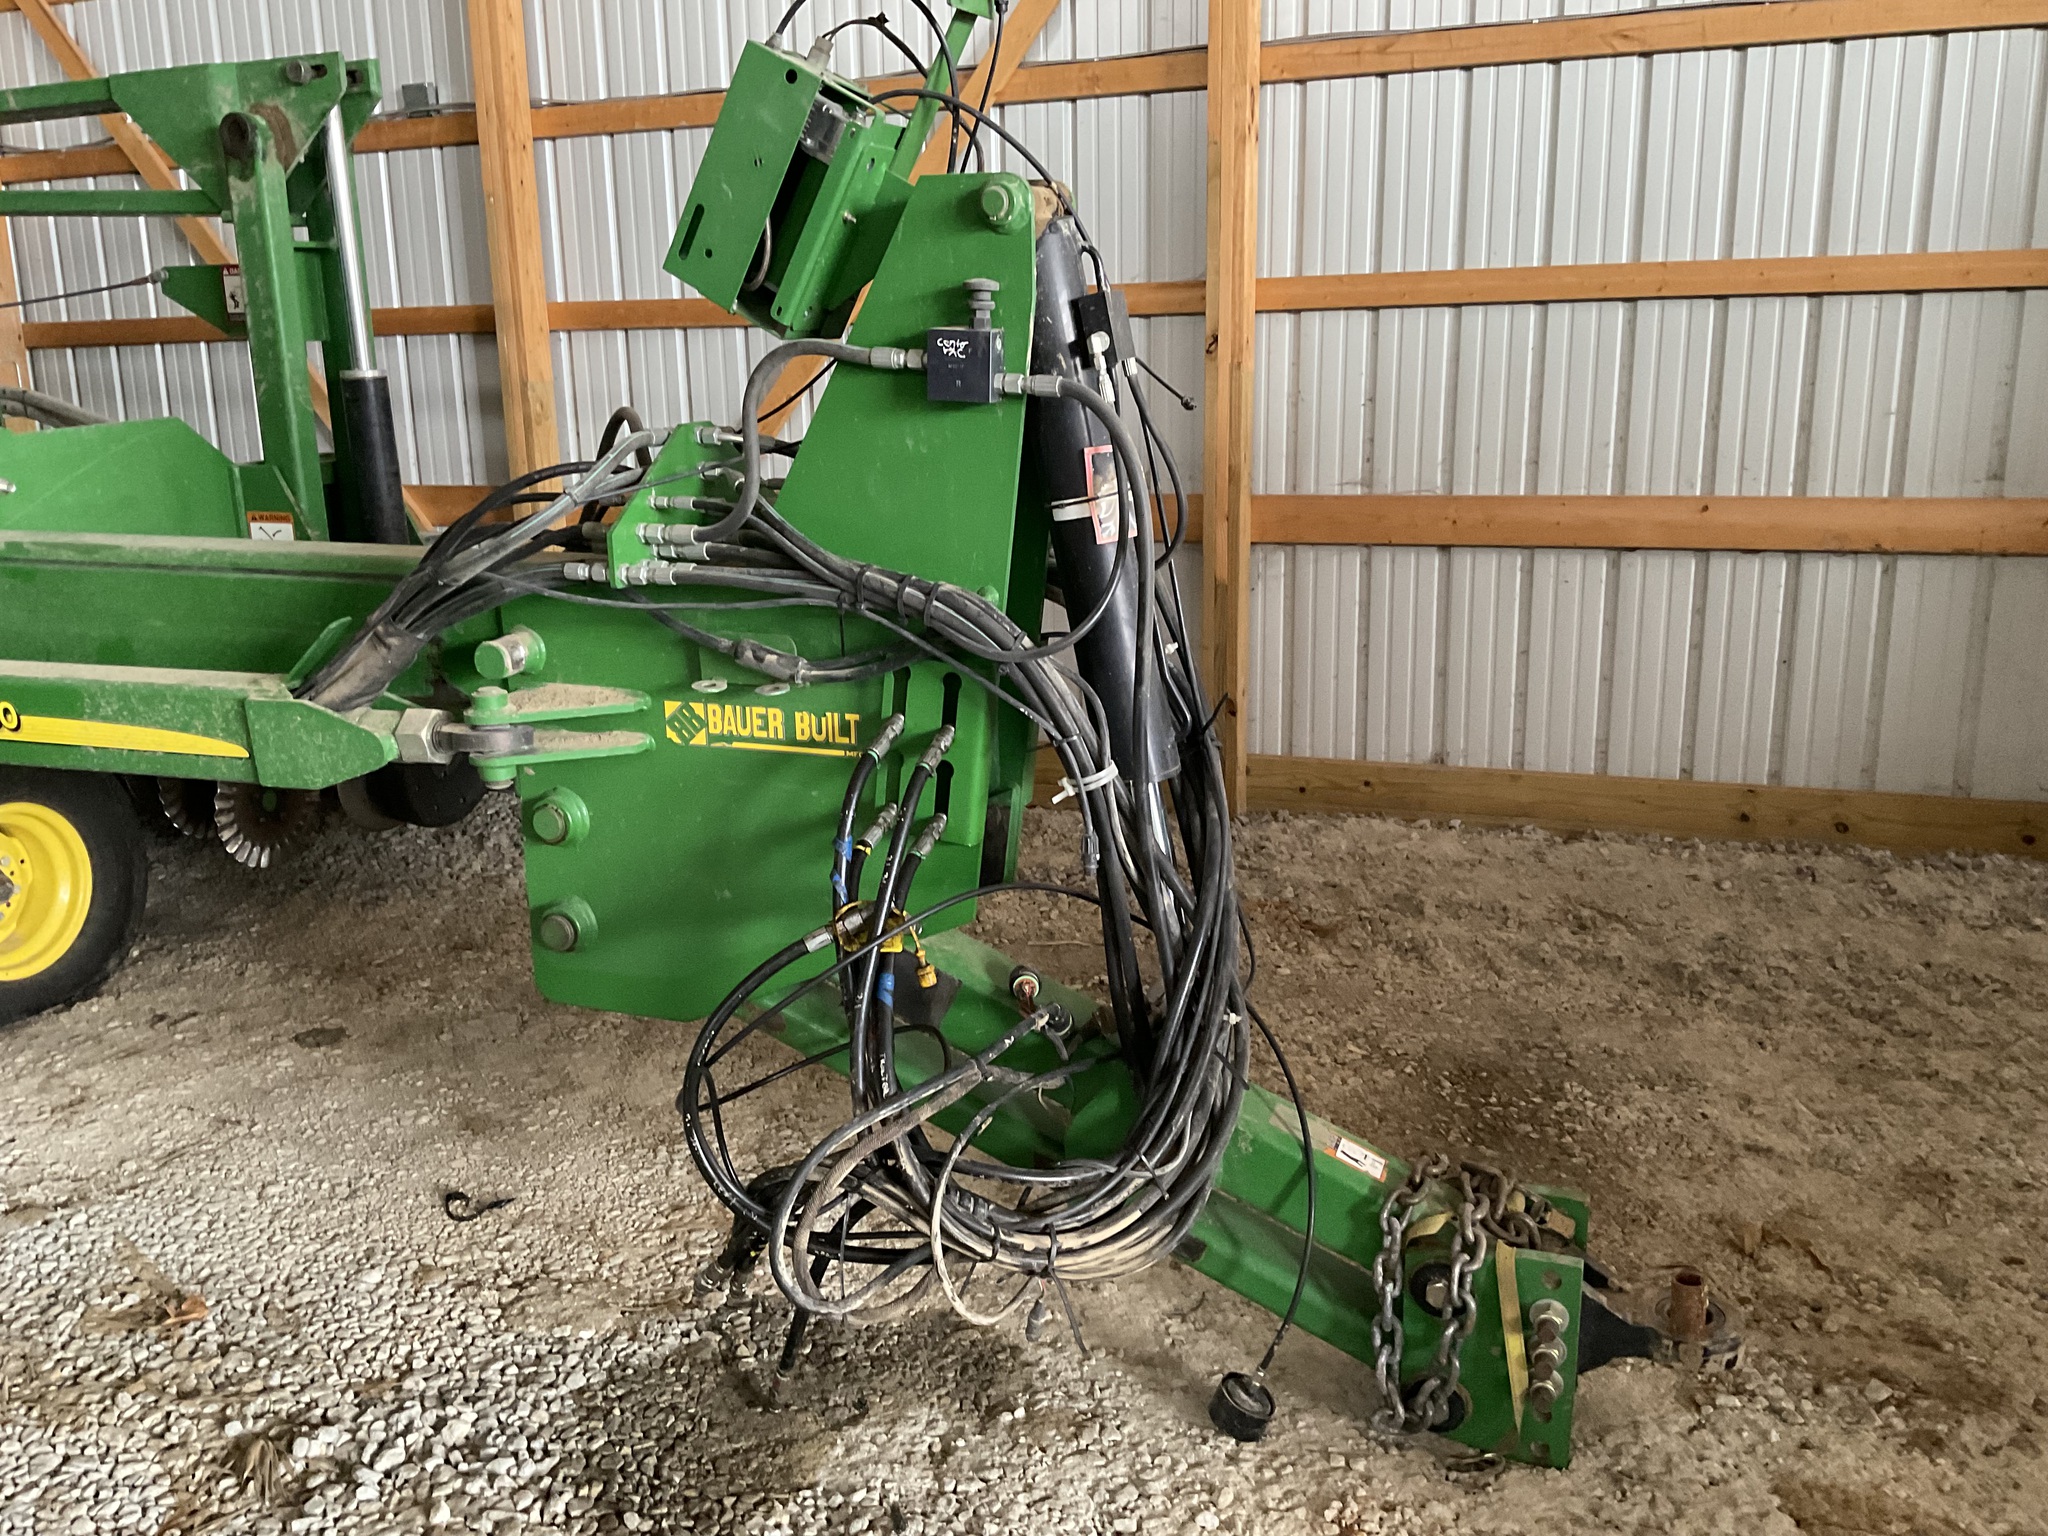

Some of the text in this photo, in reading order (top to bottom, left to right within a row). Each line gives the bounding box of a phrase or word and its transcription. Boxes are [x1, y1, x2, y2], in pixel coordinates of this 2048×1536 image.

[258, 513, 291, 523] WARNING
[706, 702, 860, 745] BAUER BUILT
